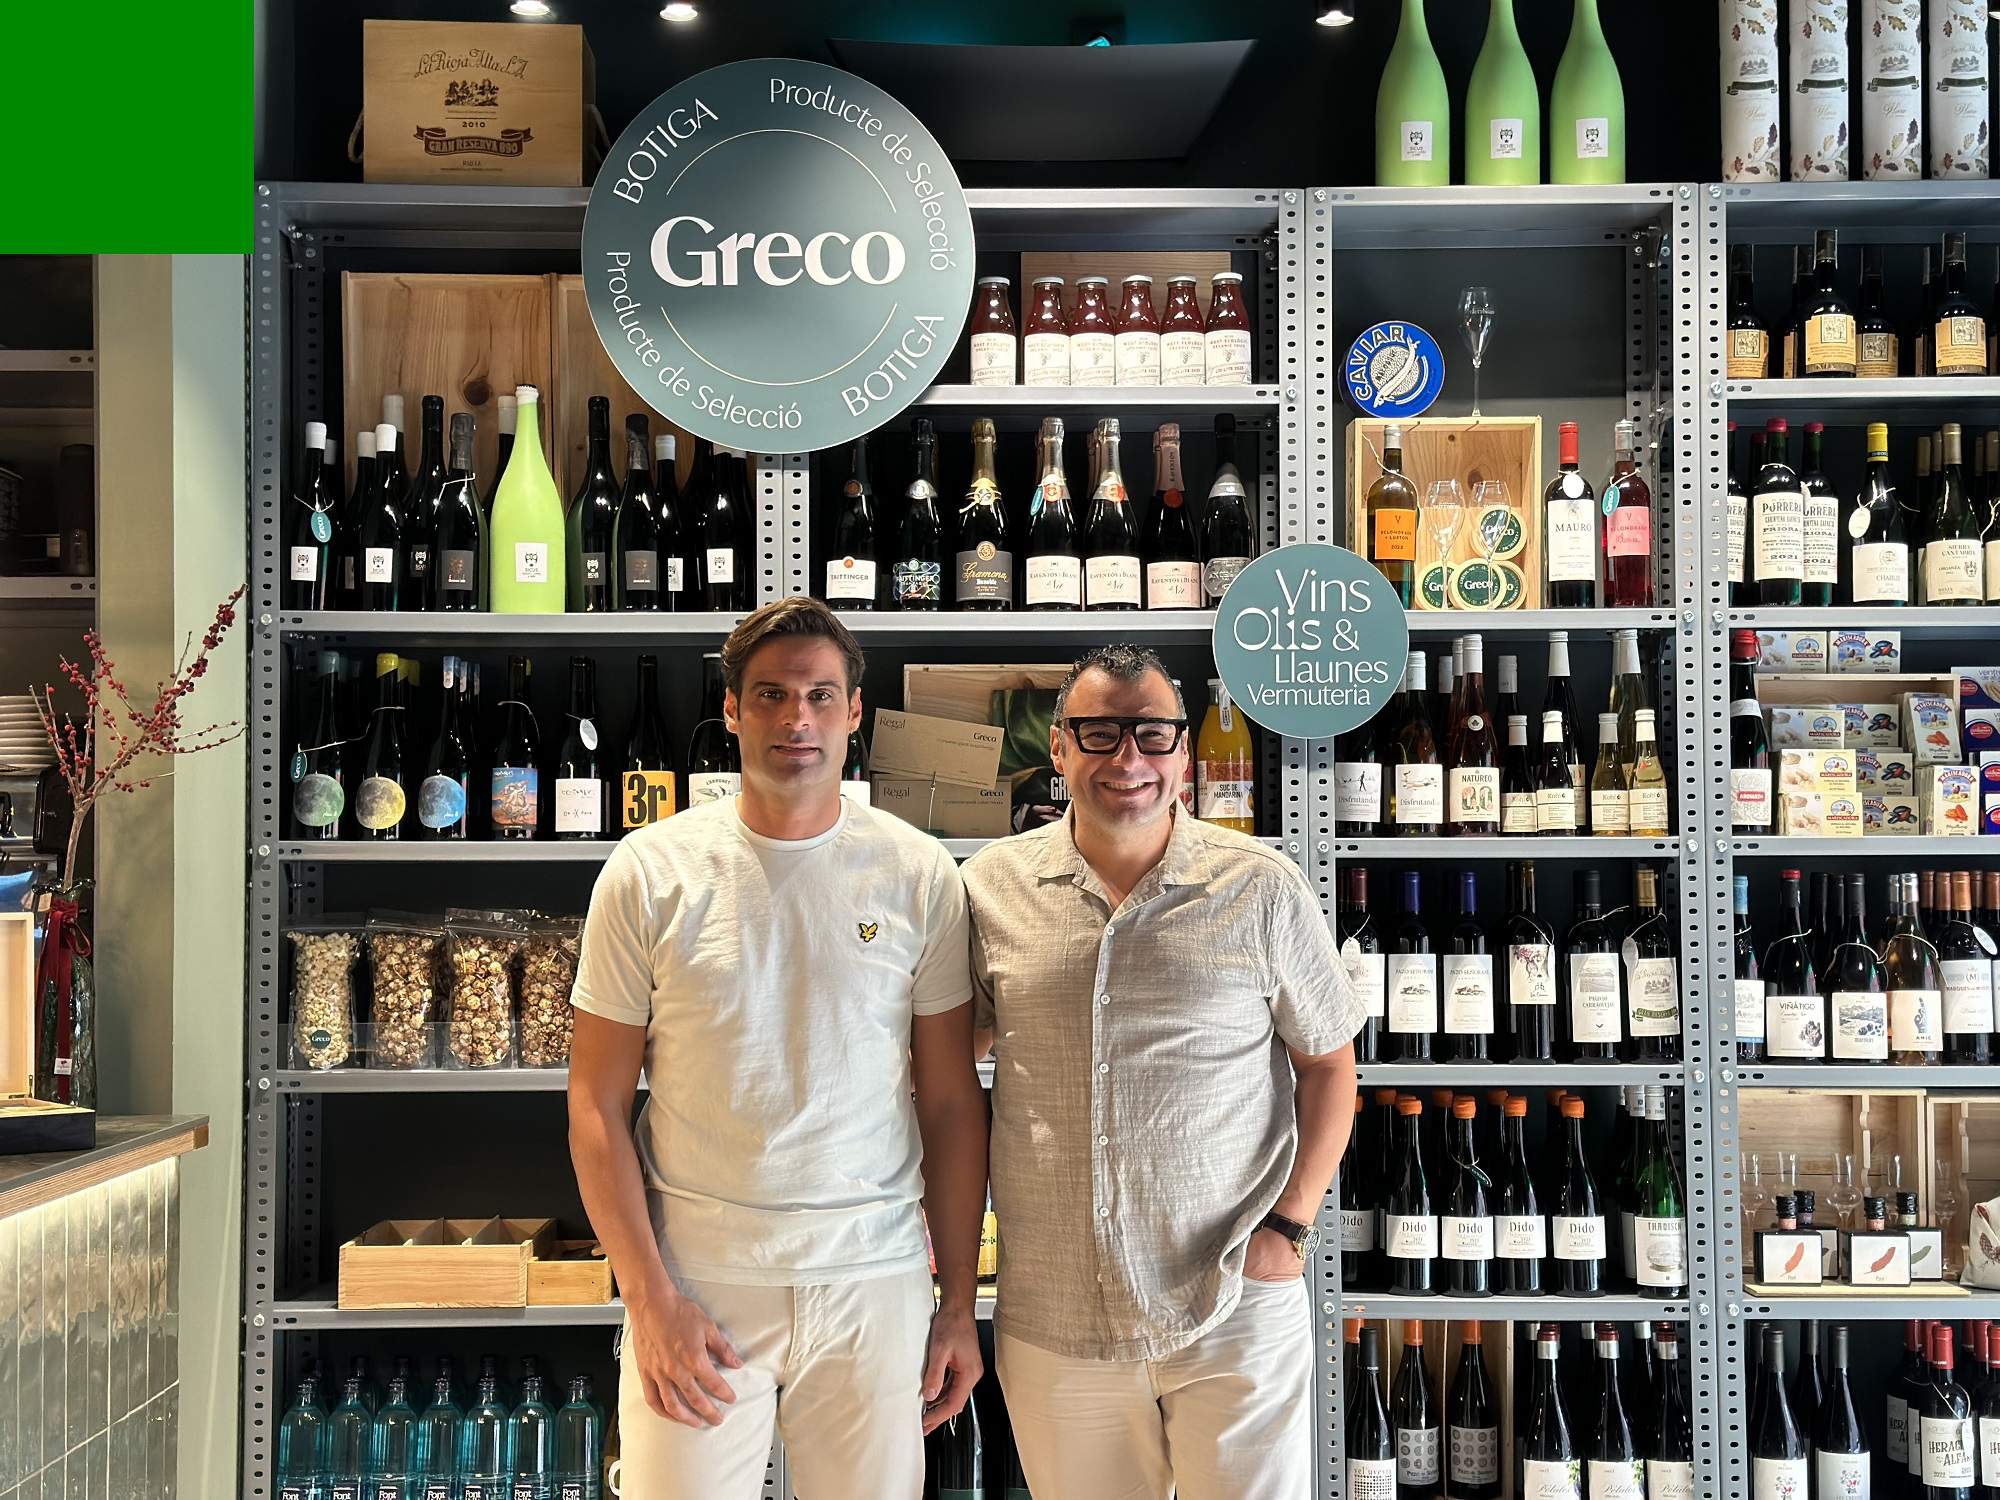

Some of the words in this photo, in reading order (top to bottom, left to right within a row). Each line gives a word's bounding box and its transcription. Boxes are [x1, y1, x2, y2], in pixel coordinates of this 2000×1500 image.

[456, 139, 499, 152] RESERVA
[613, 98, 719, 204] BOTIGA
[770, 78, 883, 138] Producte
[882, 134, 914, 165] de
[906, 162, 957, 271] Selecció
[650, 215, 906, 287] Greco
[605, 252, 661, 368] Producte
[658, 365, 691, 397] de
[691, 384, 803, 430] Selecció
[841, 314, 945, 417] BOTIGA
[1349, 325, 1406, 401] CAVIAR
[1555, 523, 1592, 533] MAURO
[961, 562, 1010, 584] Gramona
[1464, 580, 1494, 591] Greco
[1275, 569, 1372, 616] Vins
[1233, 606, 1322, 651] Olis
[1332, 618, 1360, 651] &
[1275, 651, 1389, 684] Llaunes
[1247, 684, 1372, 706] Vermuteria
[879, 716, 906, 731] Regal
[973, 732, 997, 743] Greco
[1461, 774, 1493, 782] NATUREO
[1233, 783, 1238, 791] DE
[883, 787, 910, 799] Regal
[980, 789, 1004, 797] Greco
[1214, 790, 1244, 799] MANDARINA
[627, 774, 668, 824] 3r
[1340, 1215, 1363, 1226] Dido
[1402, 1222, 1427, 1233] Dido
[1458, 1222, 1483, 1234] Dido
[1509, 1222, 1535, 1233] Dido
[1570, 1223, 1595, 1233] Dido
[283, 1491, 299, 1500] Font
[333, 1491, 351, 1500] Font
[379, 1490, 397, 1498] Font
[428, 1490, 446, 1499] Font
[465, 1489, 481, 1498] Font
[514, 1489, 532, 1498] Font
[563, 1488, 580, 1497] Font
